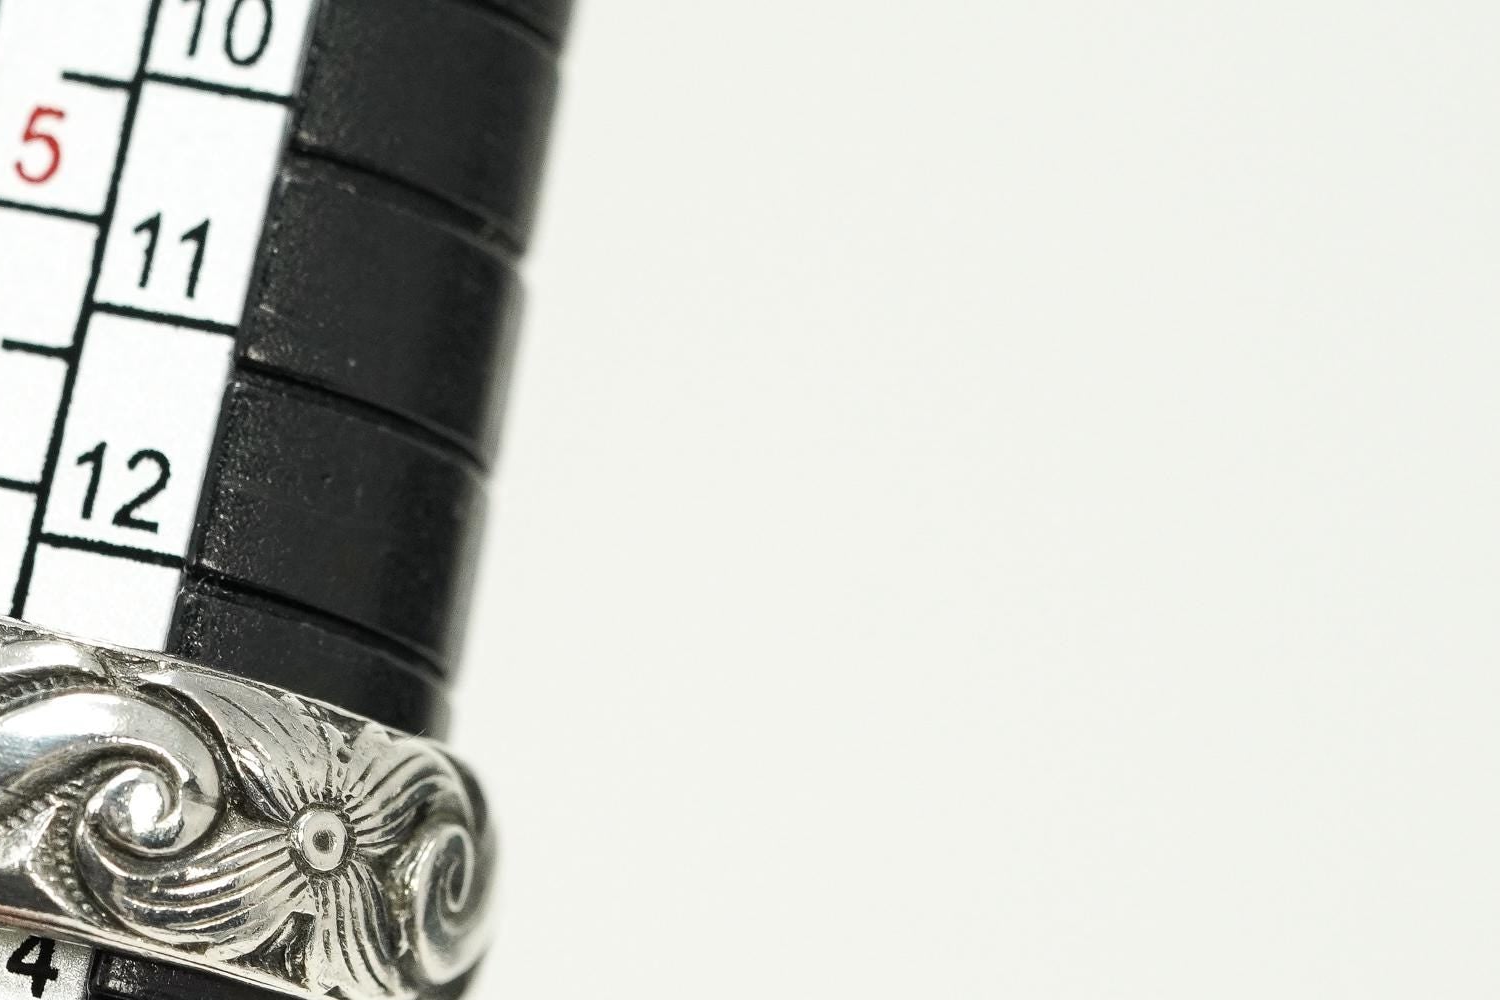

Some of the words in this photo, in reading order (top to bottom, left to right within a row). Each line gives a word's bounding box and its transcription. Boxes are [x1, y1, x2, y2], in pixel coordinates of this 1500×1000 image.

[181, 0, 274, 66] 10
[13, 106, 66, 186] 5
[132, 212, 211, 299] 11
[75, 440, 172, 534] 12
